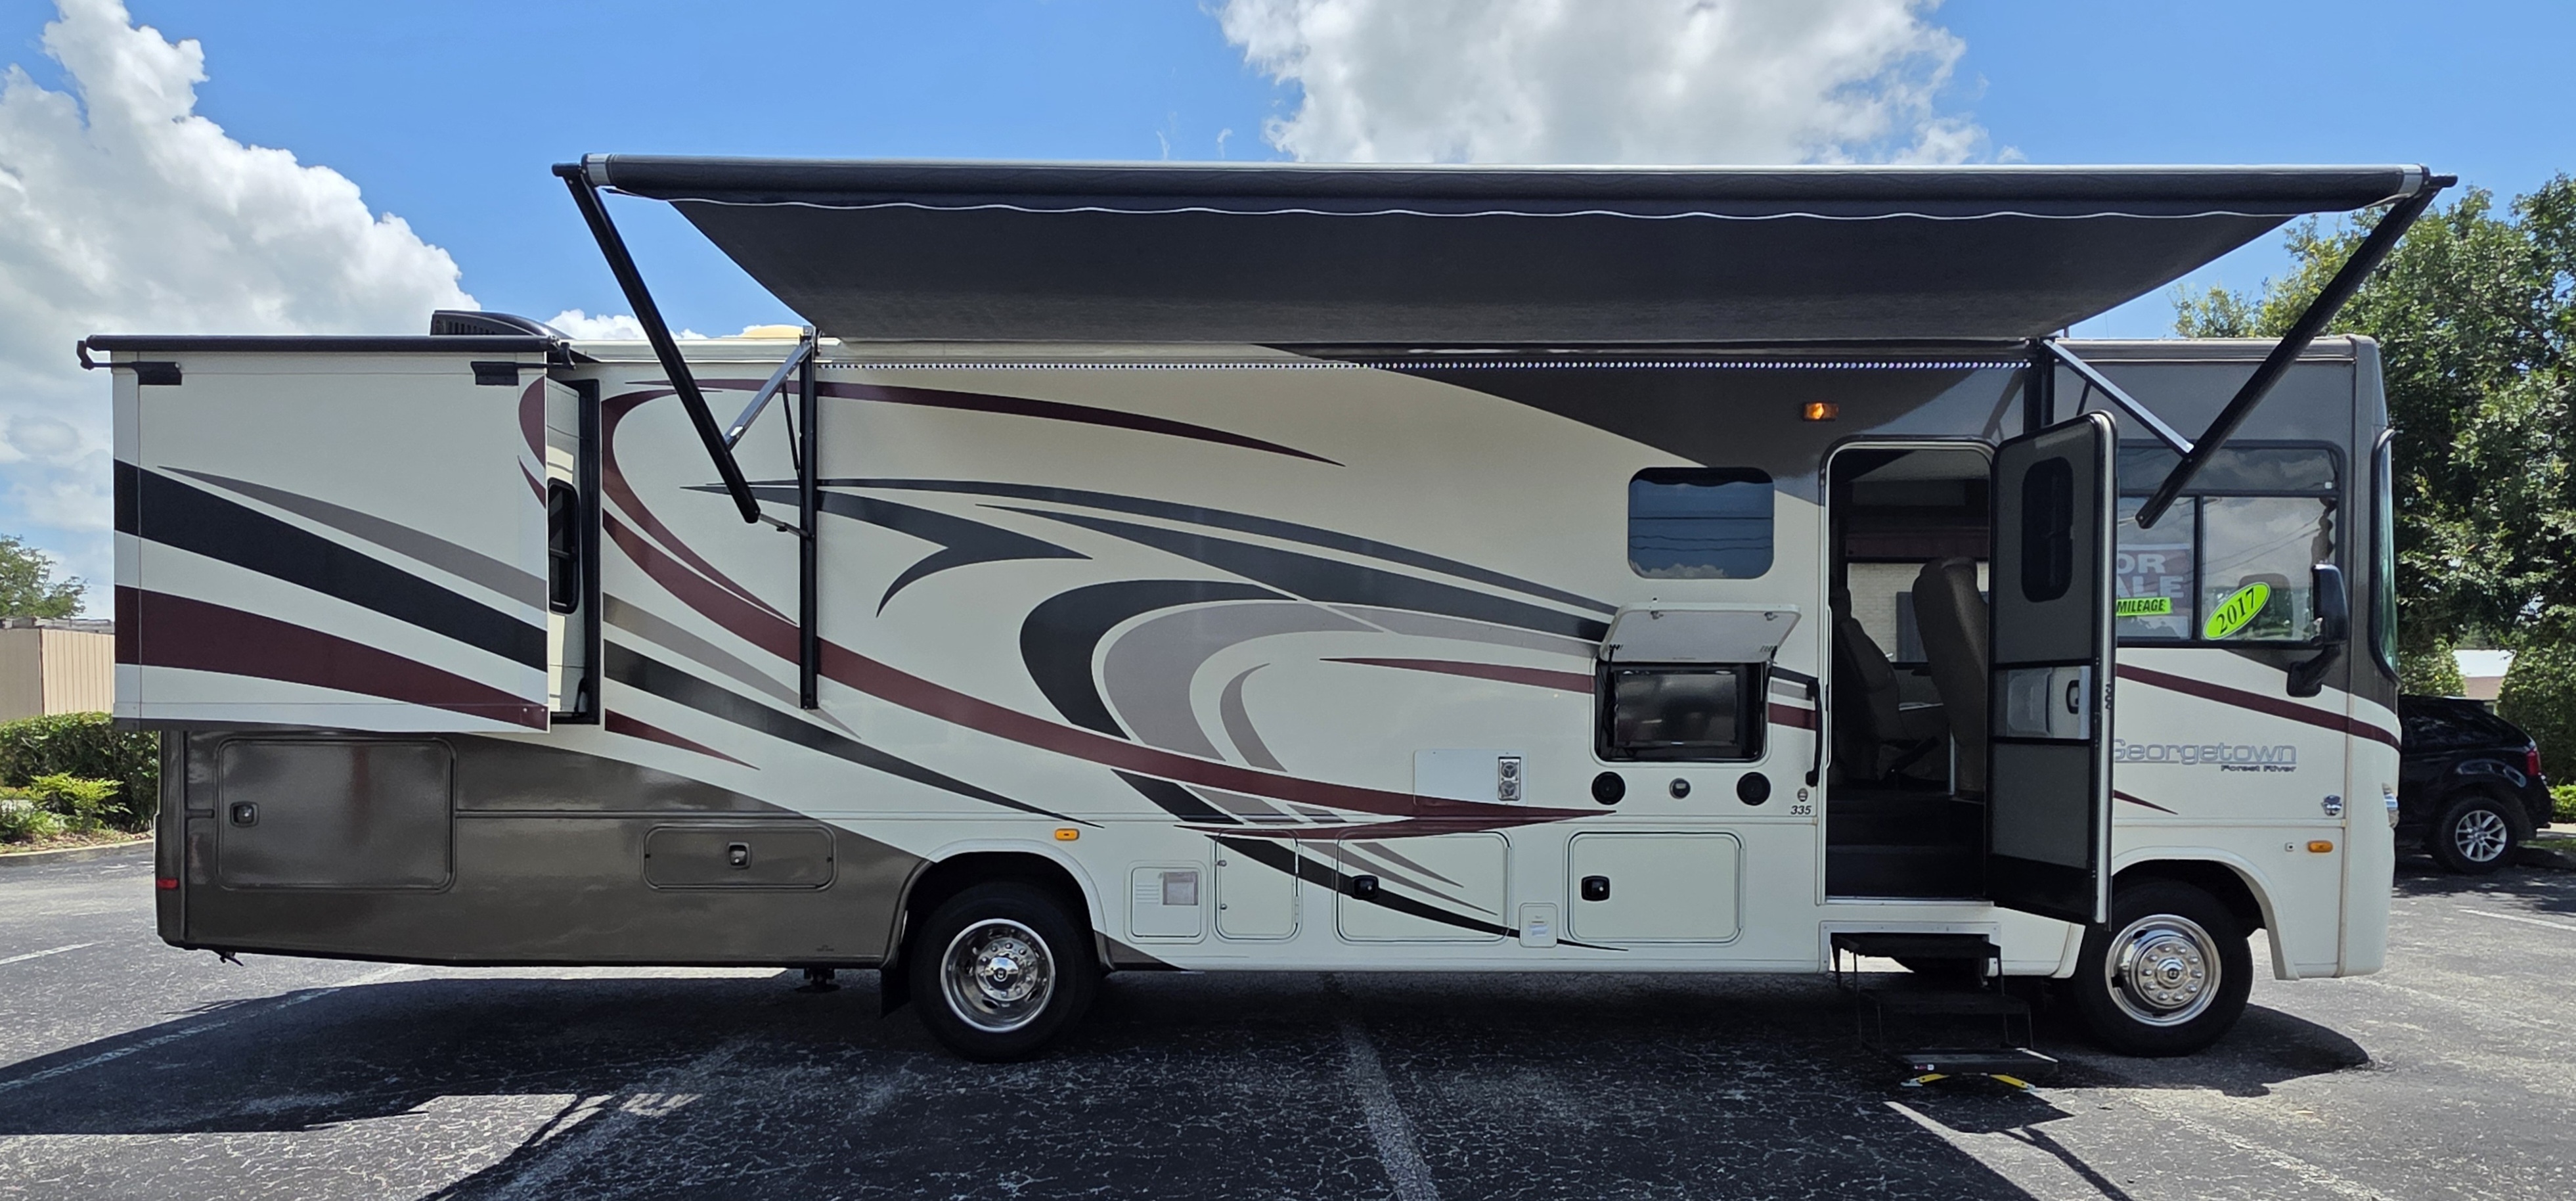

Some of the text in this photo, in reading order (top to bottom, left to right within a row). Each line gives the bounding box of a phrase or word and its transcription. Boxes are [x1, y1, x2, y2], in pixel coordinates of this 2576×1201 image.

[2116, 553, 2165, 574] OR
[2117, 599, 2167, 612] MILEAGE
[2216, 587, 2254, 635] 2017
[1790, 805, 1812, 815] 335
